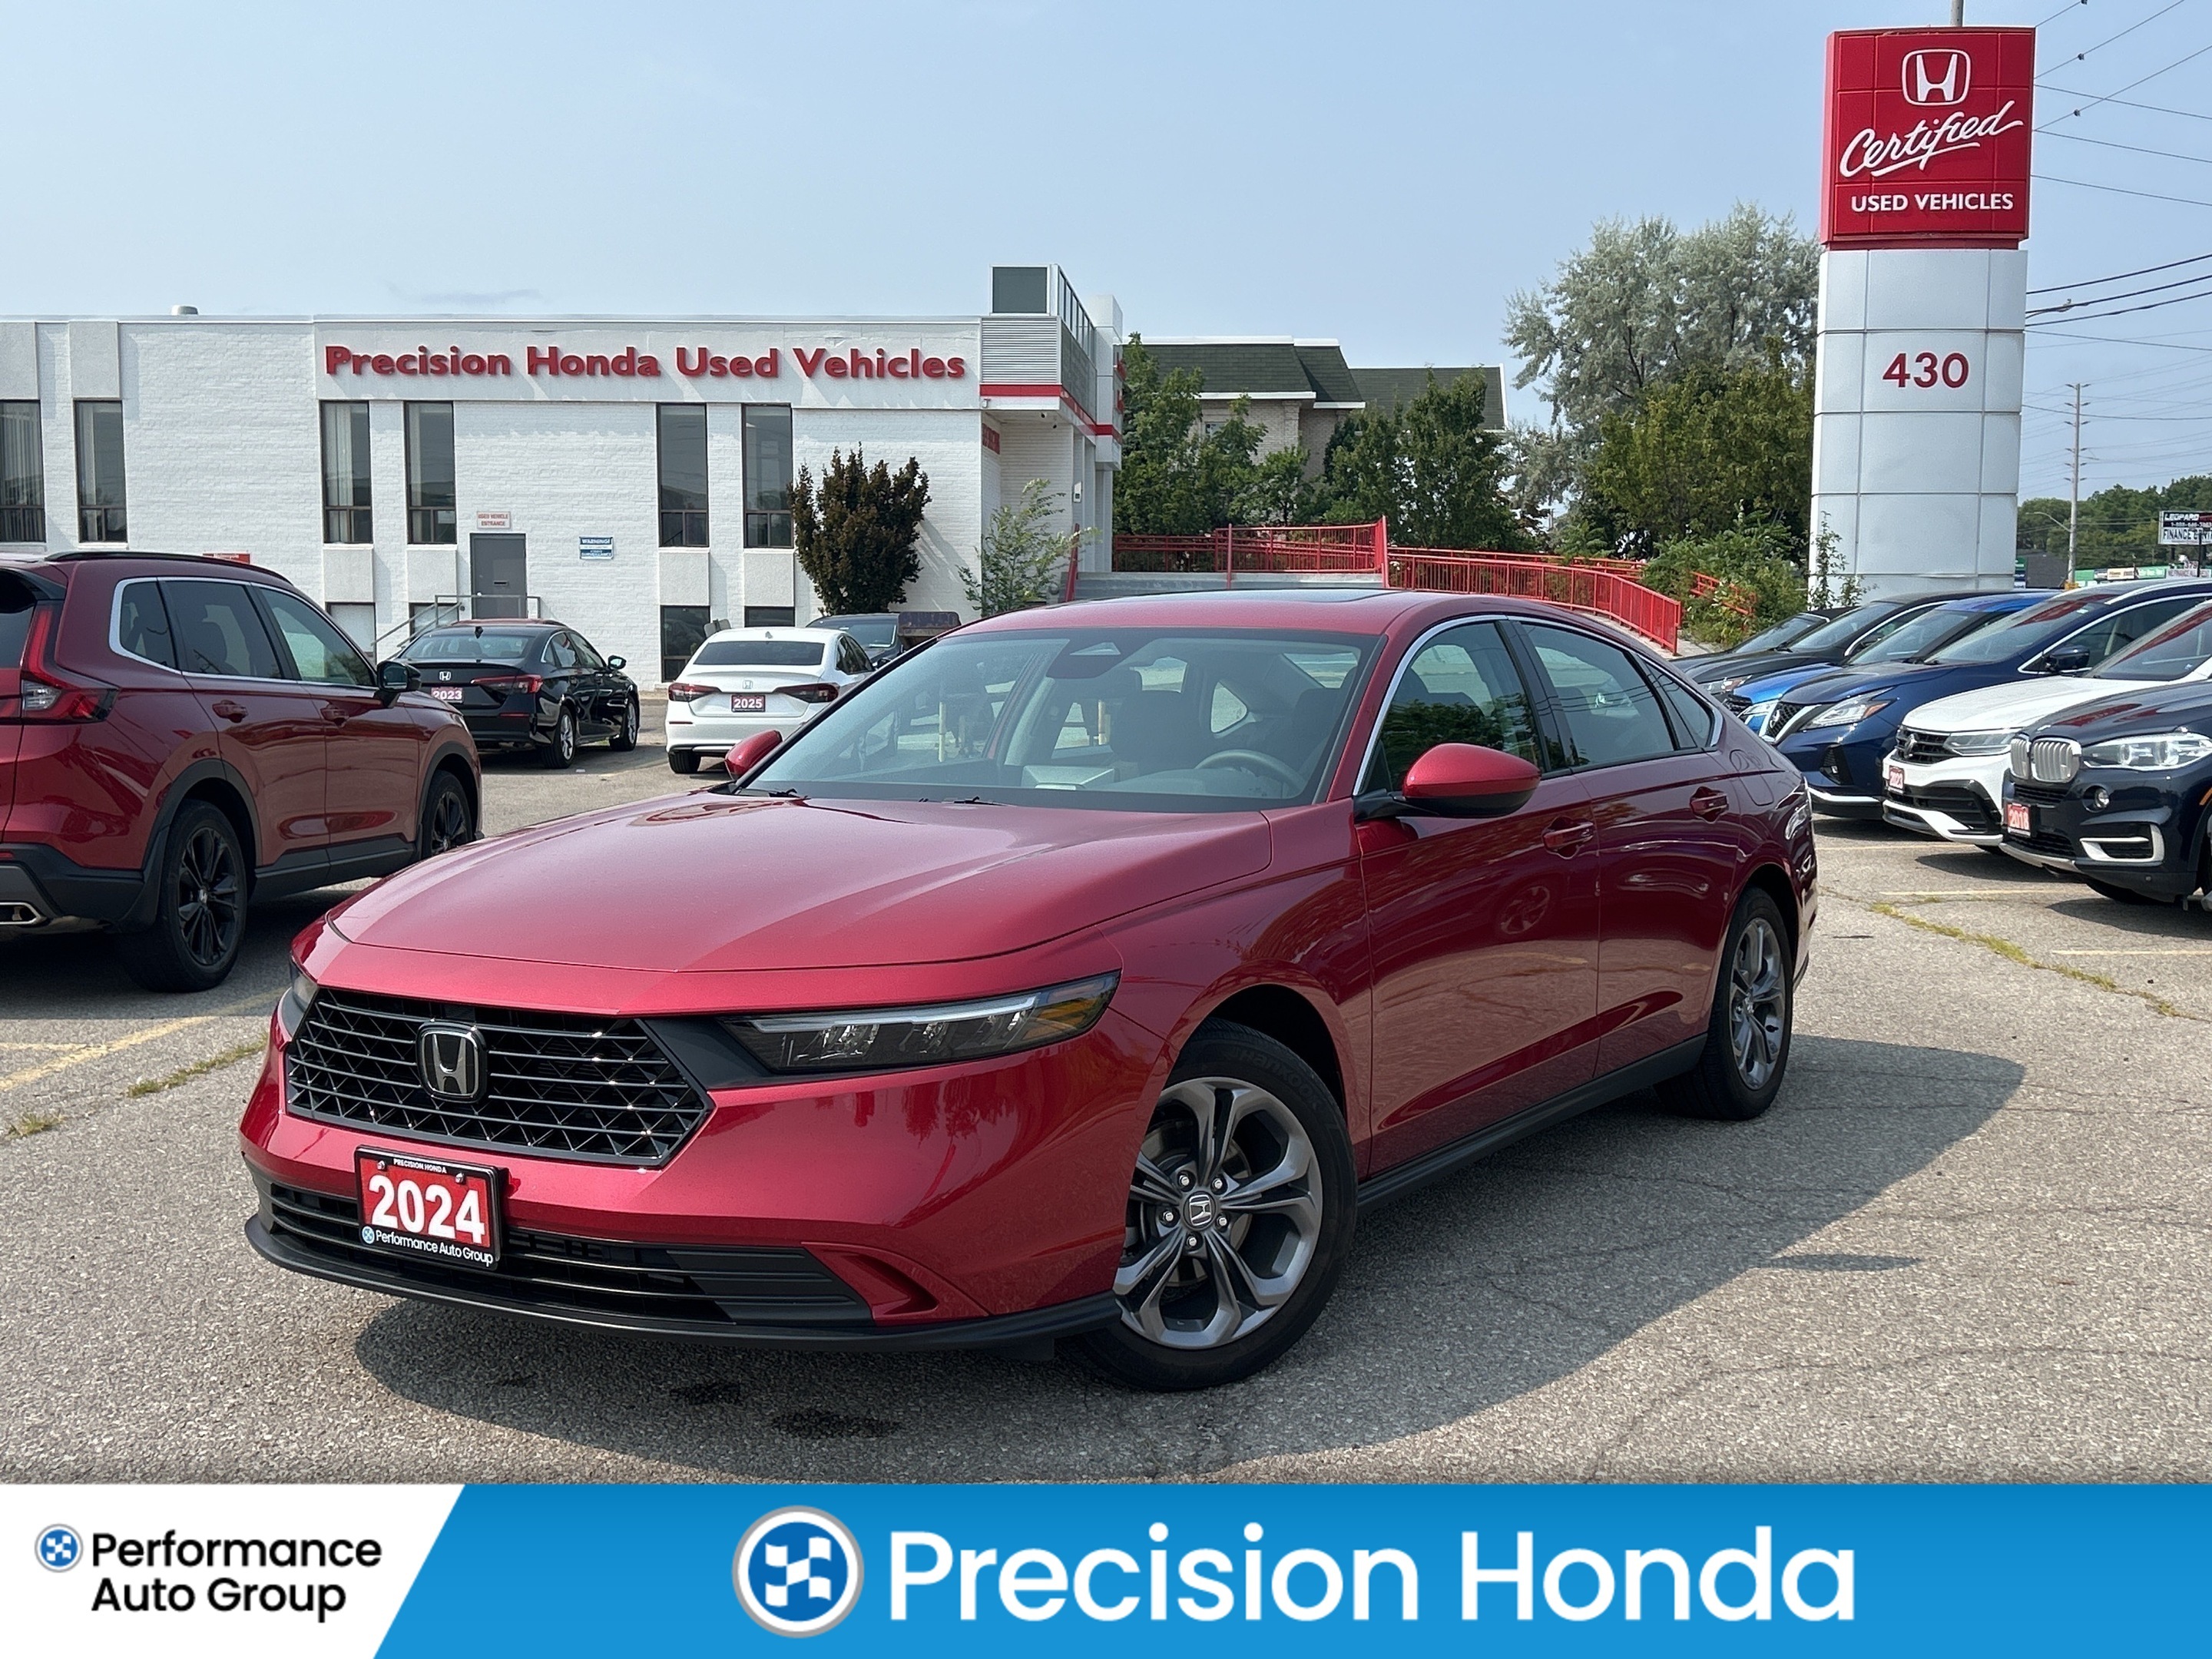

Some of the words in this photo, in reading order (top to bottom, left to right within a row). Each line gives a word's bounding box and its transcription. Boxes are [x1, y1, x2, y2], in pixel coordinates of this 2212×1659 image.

[1839, 101, 2024, 177] Certified
[1851, 195, 1908, 212] USED
[1914, 193, 2014, 210] VEHICLES
[325, 345, 511, 376] Precision
[527, 346, 661, 376] Honda
[676, 347, 779, 377] Used
[793, 347, 965, 378] Vehicles
[1883, 352, 1969, 389] 430
[2164, 513, 2200, 522] LEOPARD
[2163, 528, 2191, 540] FINANCE
[432, 690, 462, 700] 2023
[733, 698, 763, 708] 2025
[2008, 808, 2030, 830] 2018
[392, 1157, 424, 1171] PRECISION
[424, 1163, 448, 1174] HONDA
[369, 1174, 485, 1244] 2024
[376, 1230, 439, 1253] Performance
[439, 1241, 462, 1258] Auto
[462, 1247, 494, 1267] Group
